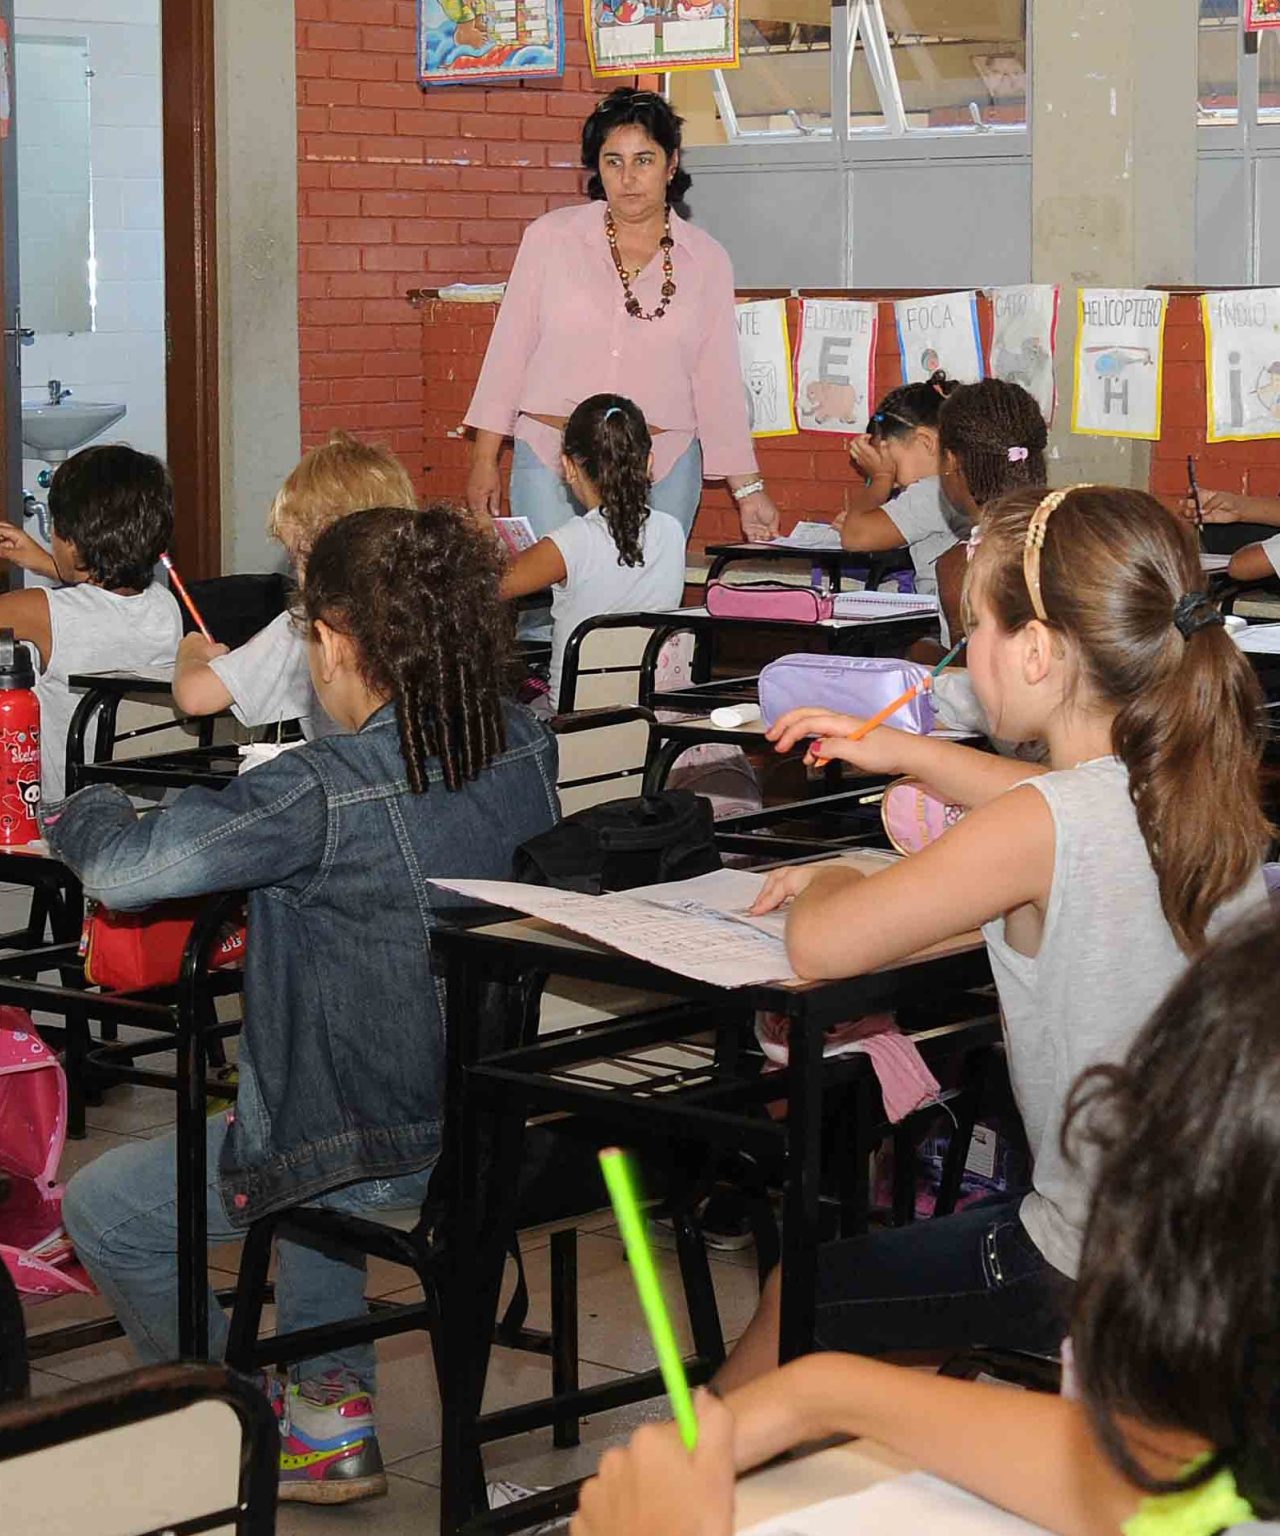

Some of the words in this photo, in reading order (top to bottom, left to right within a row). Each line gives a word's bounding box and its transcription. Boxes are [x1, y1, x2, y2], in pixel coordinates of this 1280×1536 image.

[906, 306, 955, 332] FOCA
[819, 336, 853, 386] E
[1103, 377, 1129, 416] H
